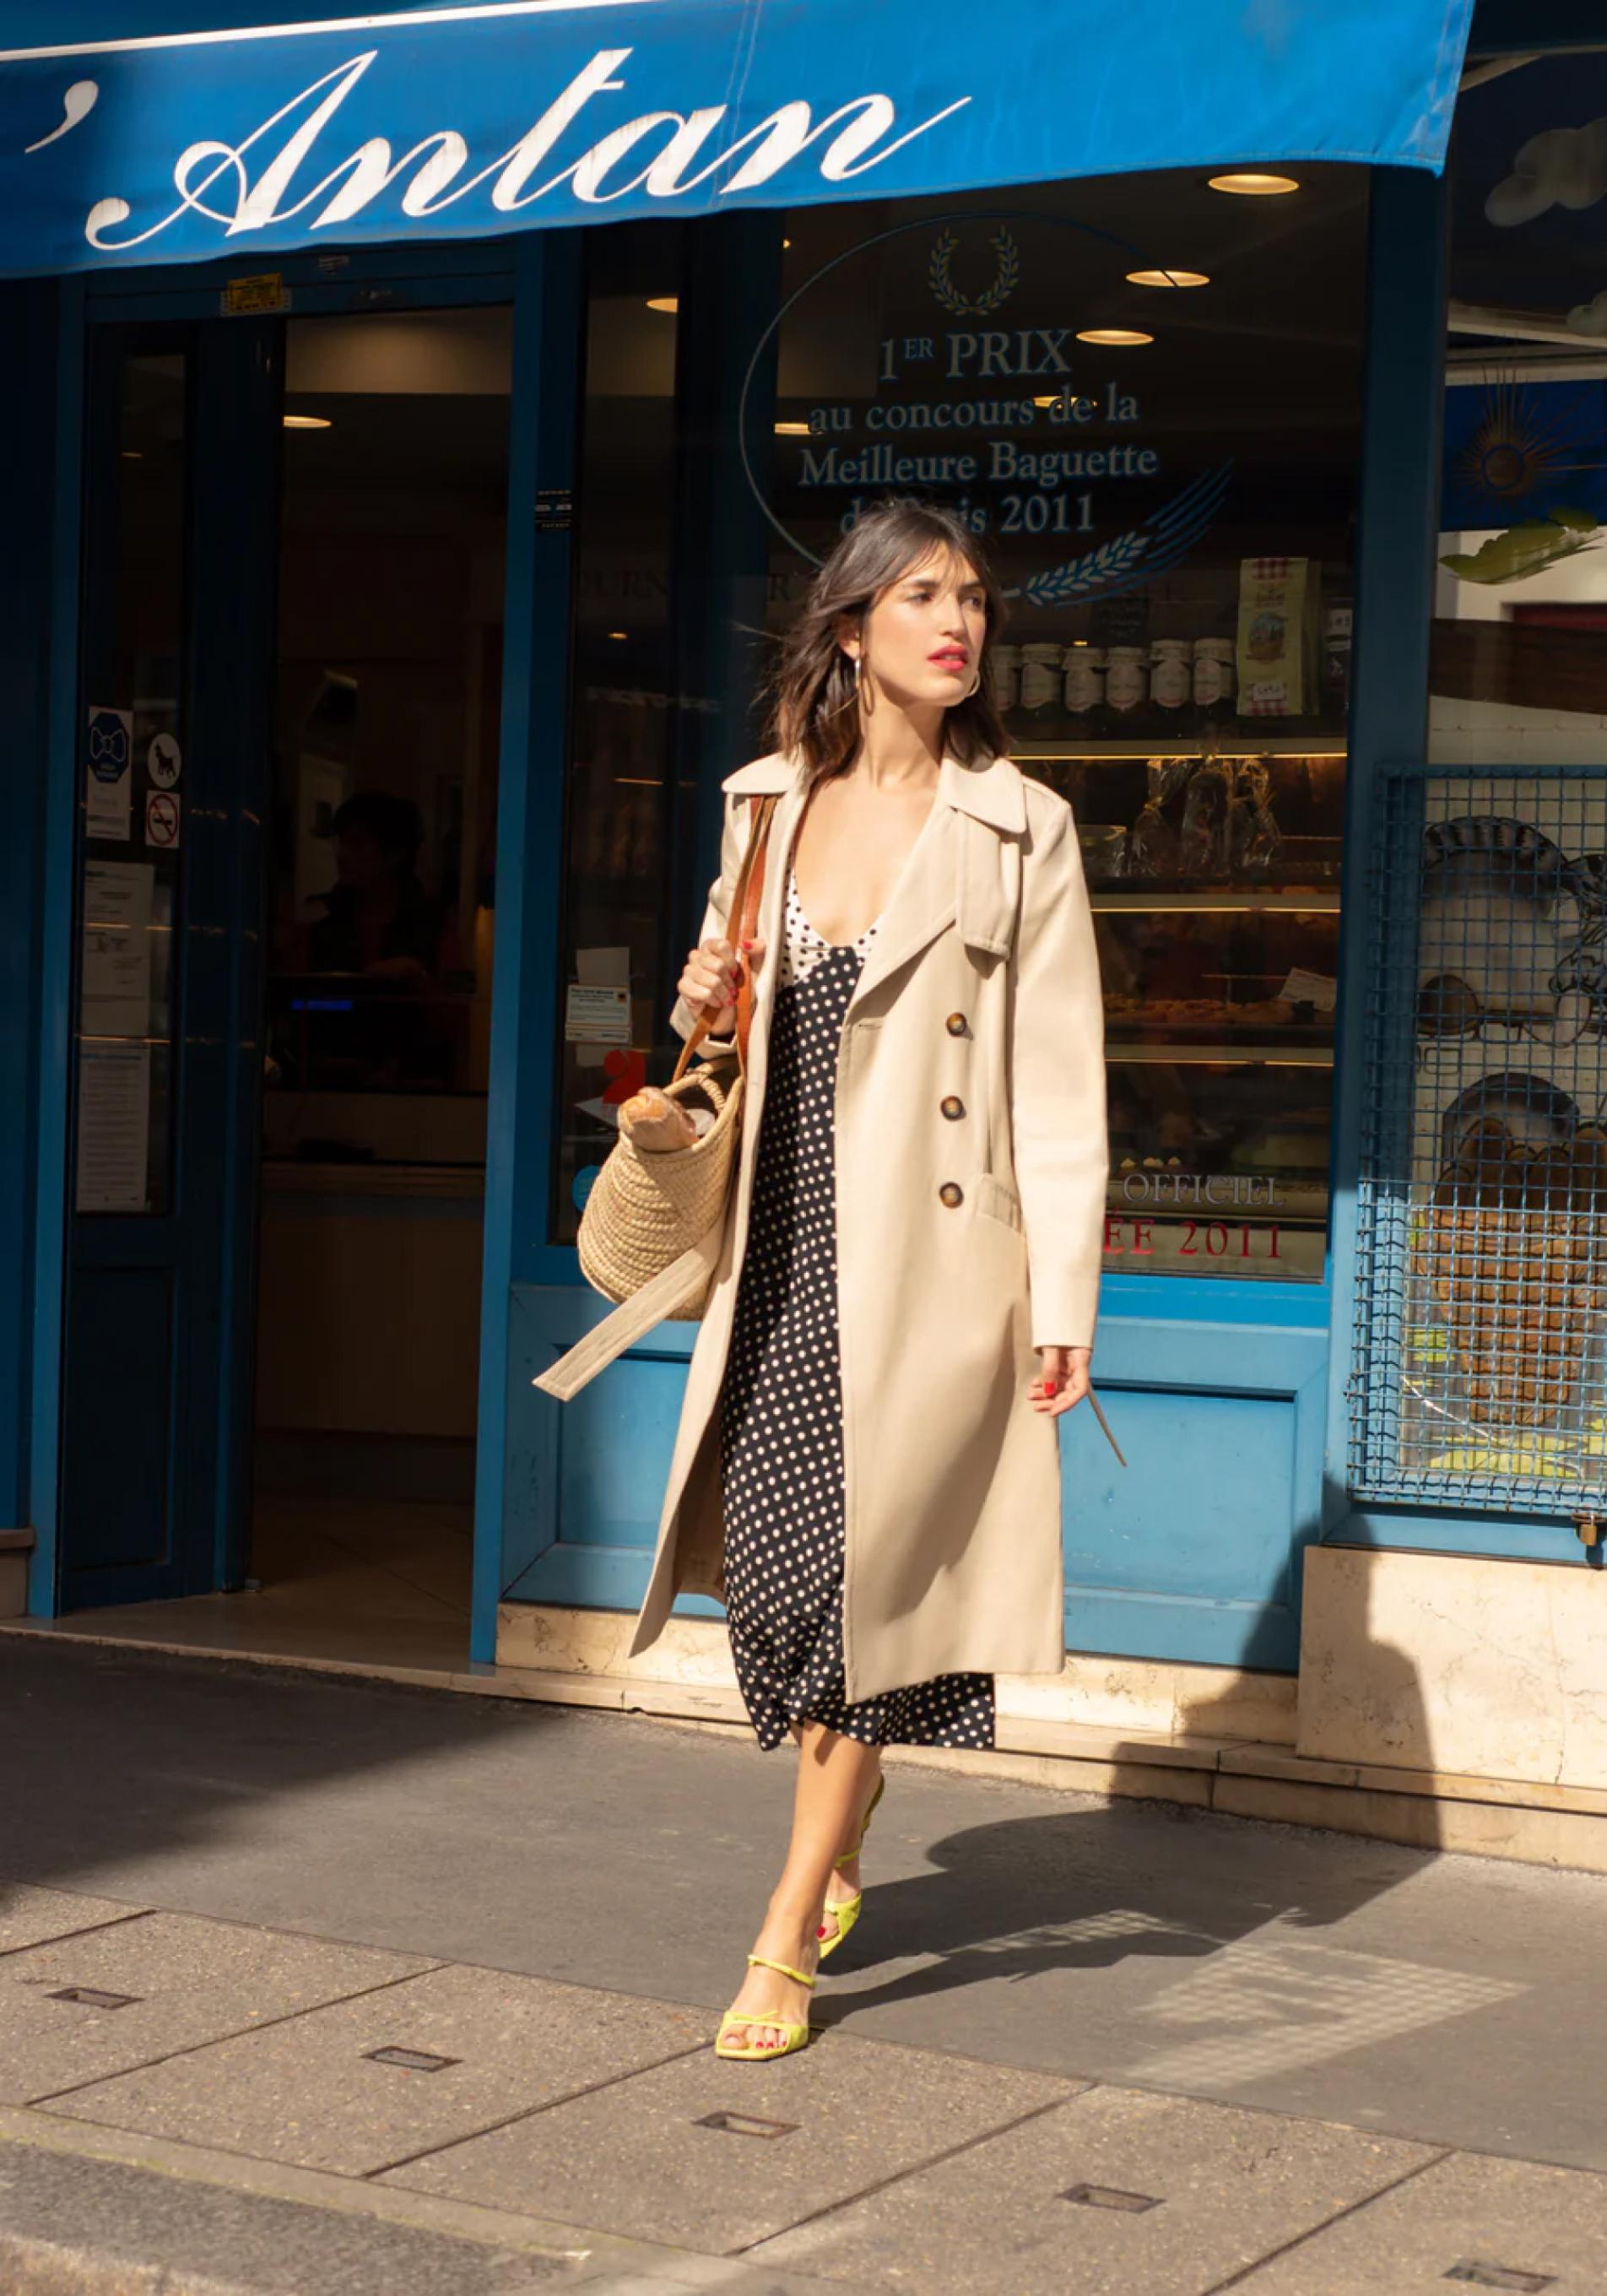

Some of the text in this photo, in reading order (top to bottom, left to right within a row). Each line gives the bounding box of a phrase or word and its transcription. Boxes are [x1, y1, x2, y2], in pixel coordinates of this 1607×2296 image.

[878, 328, 1073, 382] 1ER PRIX
[809, 381, 1139, 433] au concours de la
[799, 440, 1160, 487] Meilleure Baguette
[1000, 492, 1095, 533] 2011
[1123, 1173, 1284, 1205] OFFICIEL
[1177, 1221, 1282, 1259] 2011
